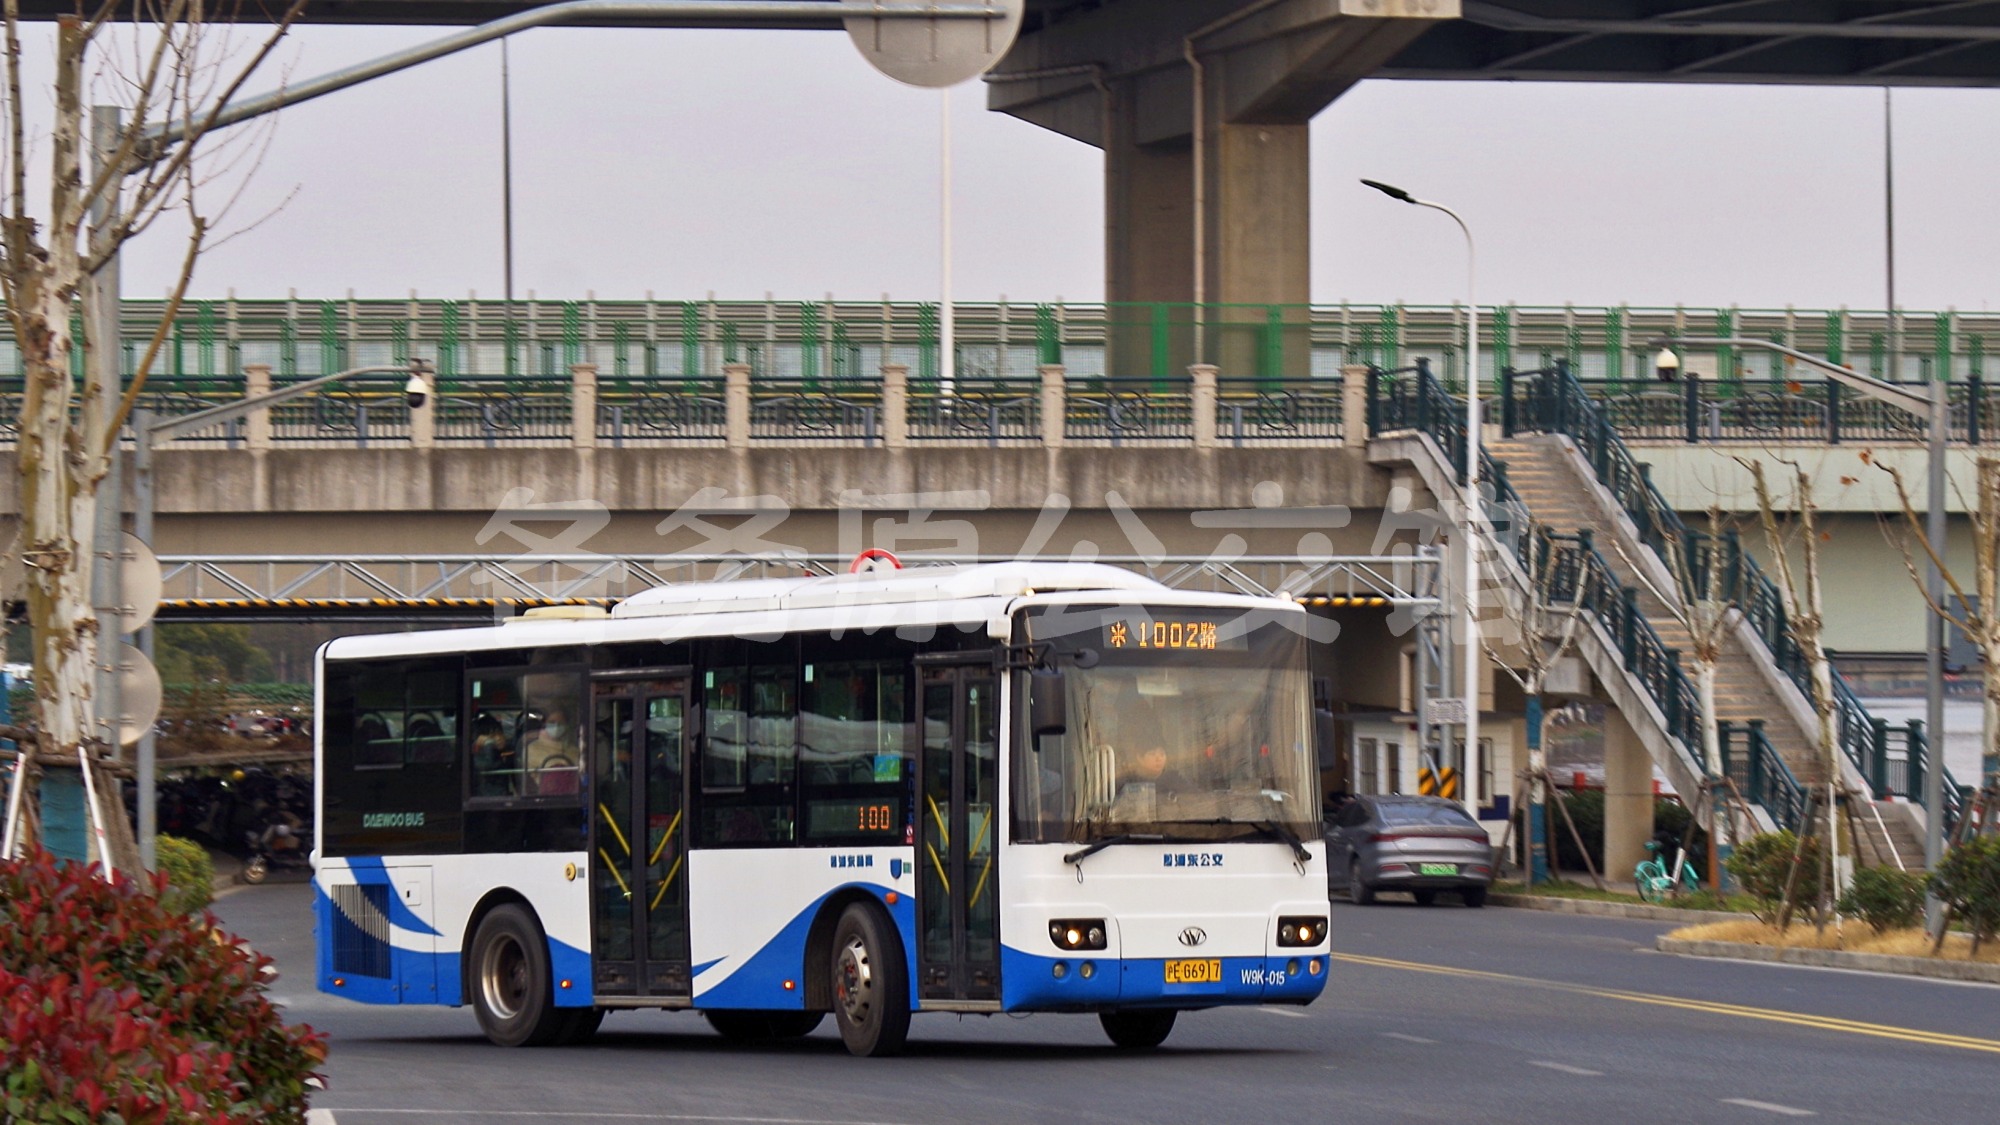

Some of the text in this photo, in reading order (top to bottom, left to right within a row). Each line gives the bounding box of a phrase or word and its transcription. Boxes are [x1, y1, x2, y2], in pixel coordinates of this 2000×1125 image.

[363, 812, 425, 828] DAEWOO BUS
[858, 806, 890, 830] 100
[1241, 969, 1285, 985] W9K-015
